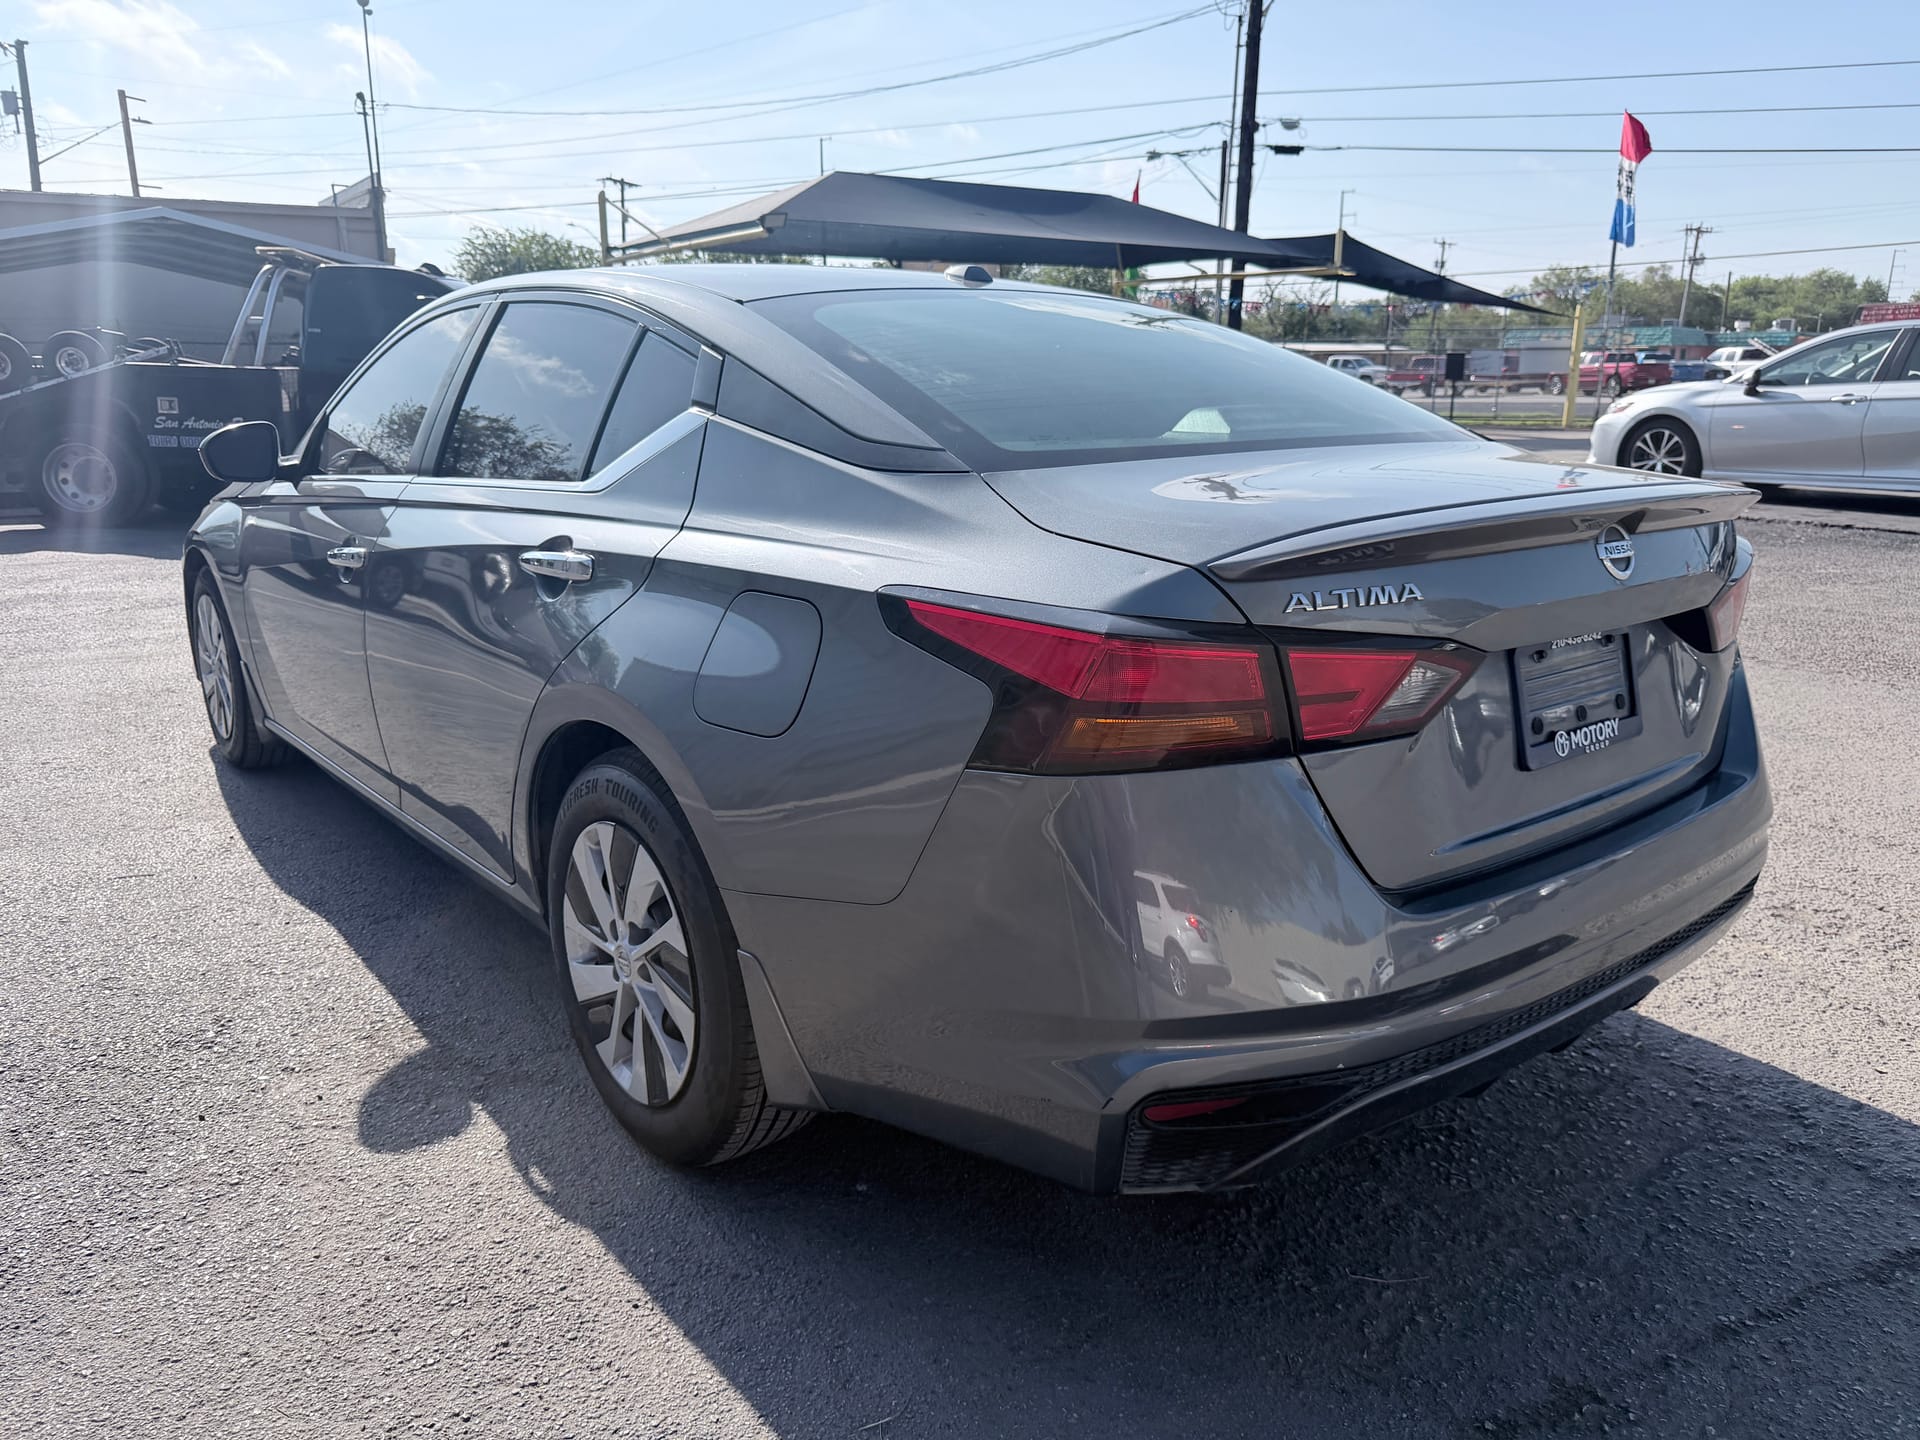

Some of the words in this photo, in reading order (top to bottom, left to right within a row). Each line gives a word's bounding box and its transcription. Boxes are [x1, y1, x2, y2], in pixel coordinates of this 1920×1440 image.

[154, 416, 179, 429] San
[1603, 541, 1633, 556] NISSA
[1283, 582, 1425, 613] ALTIMA
[1570, 717, 1619, 749] MOTORY
[1585, 739, 1610, 753] GROUP
[604, 778, 658, 834] TOURING
